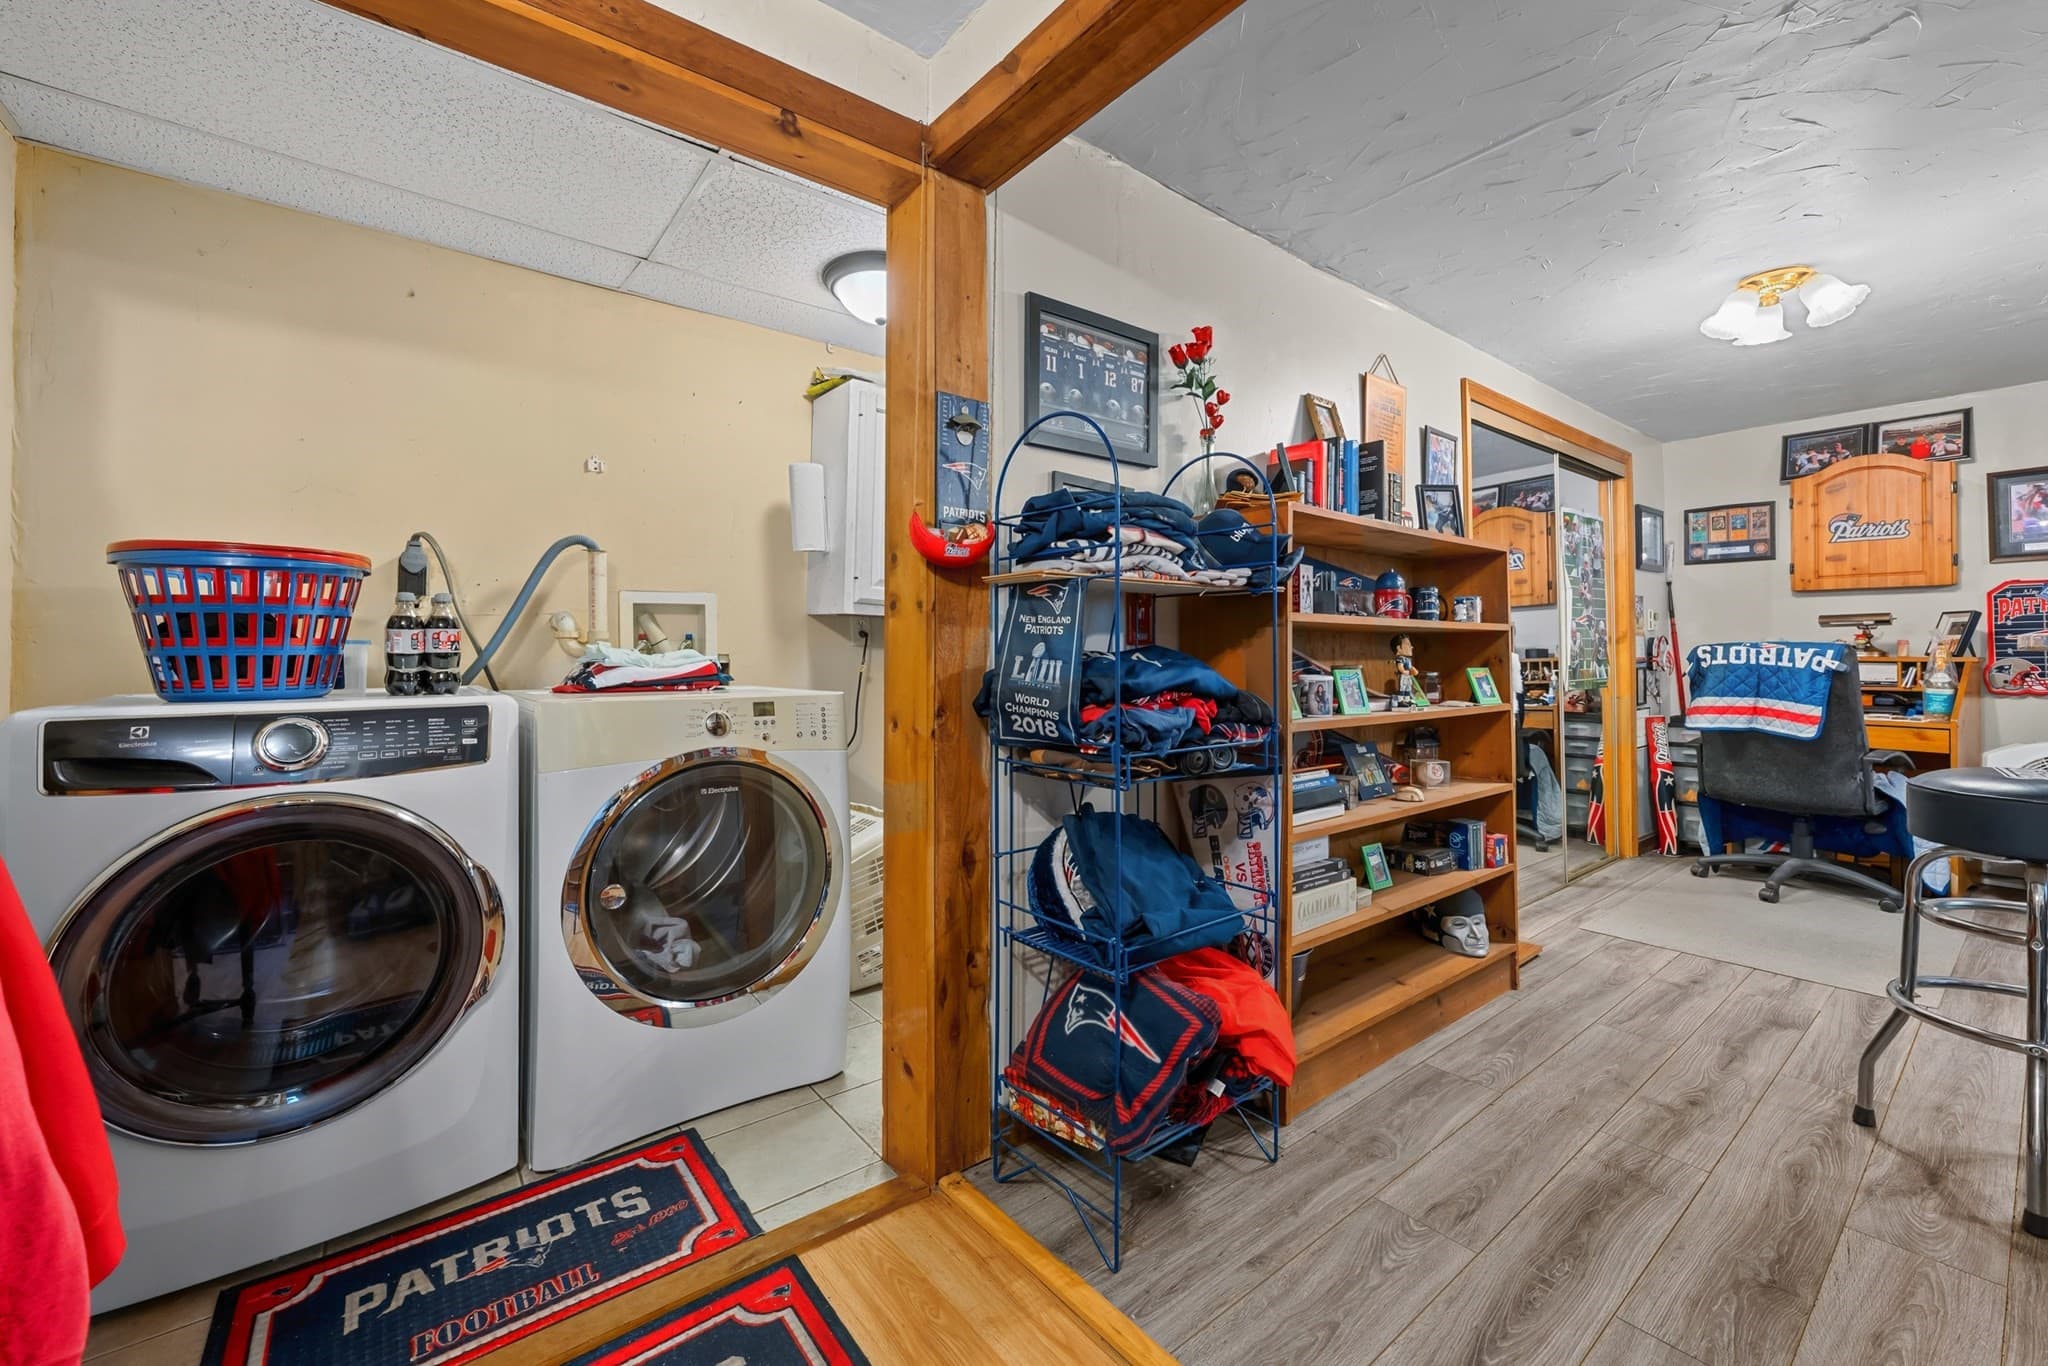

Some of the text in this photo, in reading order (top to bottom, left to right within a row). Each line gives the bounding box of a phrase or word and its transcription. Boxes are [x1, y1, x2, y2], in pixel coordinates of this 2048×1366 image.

[1046, 354, 1057, 373] 11
[1078, 363, 1084, 379] 1
[1104, 370, 1117, 388] 12
[1131, 378, 1144, 394] 87
[943, 505, 986, 523] PATRIOTS
[1828, 514, 1910, 544] Patriots
[1018, 614, 1072, 625] NEW ENGLAND
[1024, 623, 1064, 636] PATRIOTS
[1697, 645, 1835, 673] PATRIOTS
[1014, 692, 1050, 708] WORLD
[1004, 702, 1060, 721] CHAMPIONS
[1010, 714, 1060, 738] 2018
[342, 1186, 651, 1336] PATRIOTS
[409, 1263, 600, 1362] FOOTBALL
